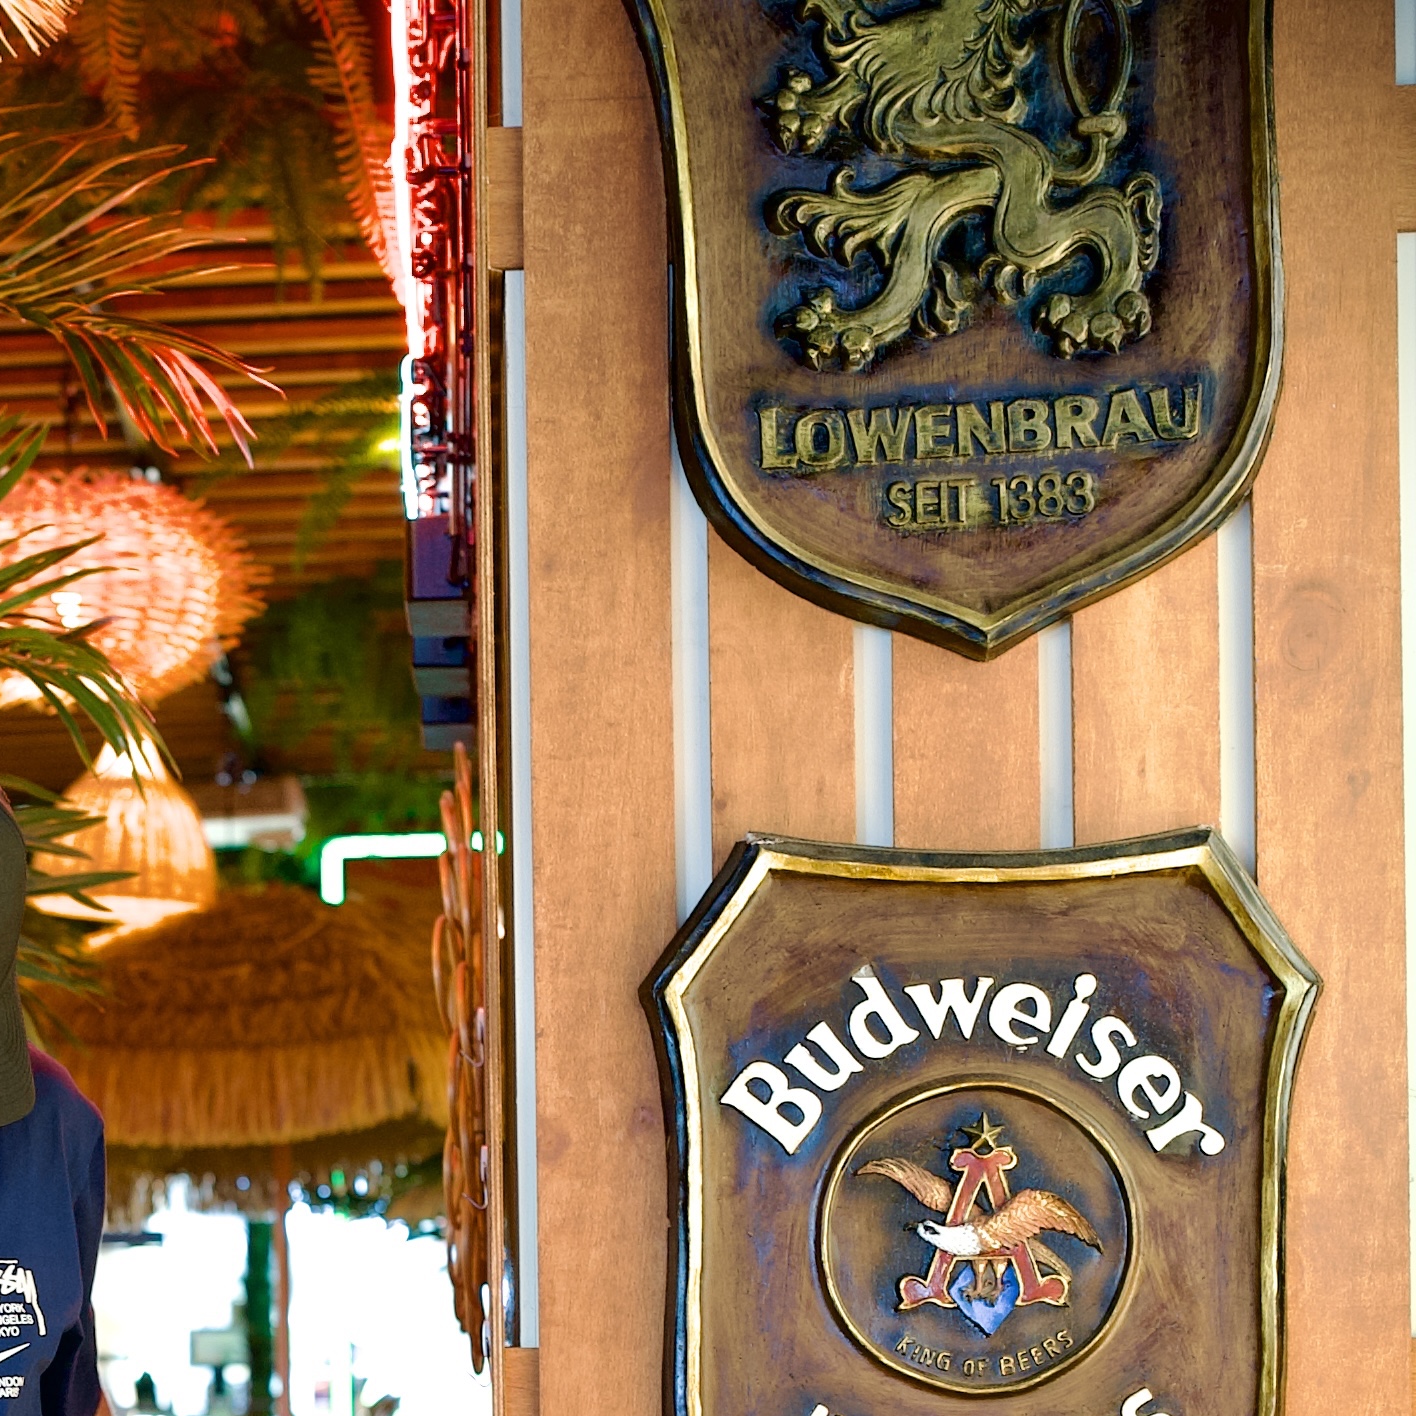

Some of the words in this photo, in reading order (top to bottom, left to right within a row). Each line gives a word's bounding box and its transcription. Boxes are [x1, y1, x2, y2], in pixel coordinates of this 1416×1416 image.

[758, 383, 1203, 470] LOWENBRAU
[887, 478, 975, 526] SEIT
[992, 470, 1096, 523] 1383
[720, 964, 1226, 1156] Budweiser
[895, 1335, 953, 1372] KING
[963, 1358, 989, 1377] OF
[999, 1329, 1074, 1377] BEERS
